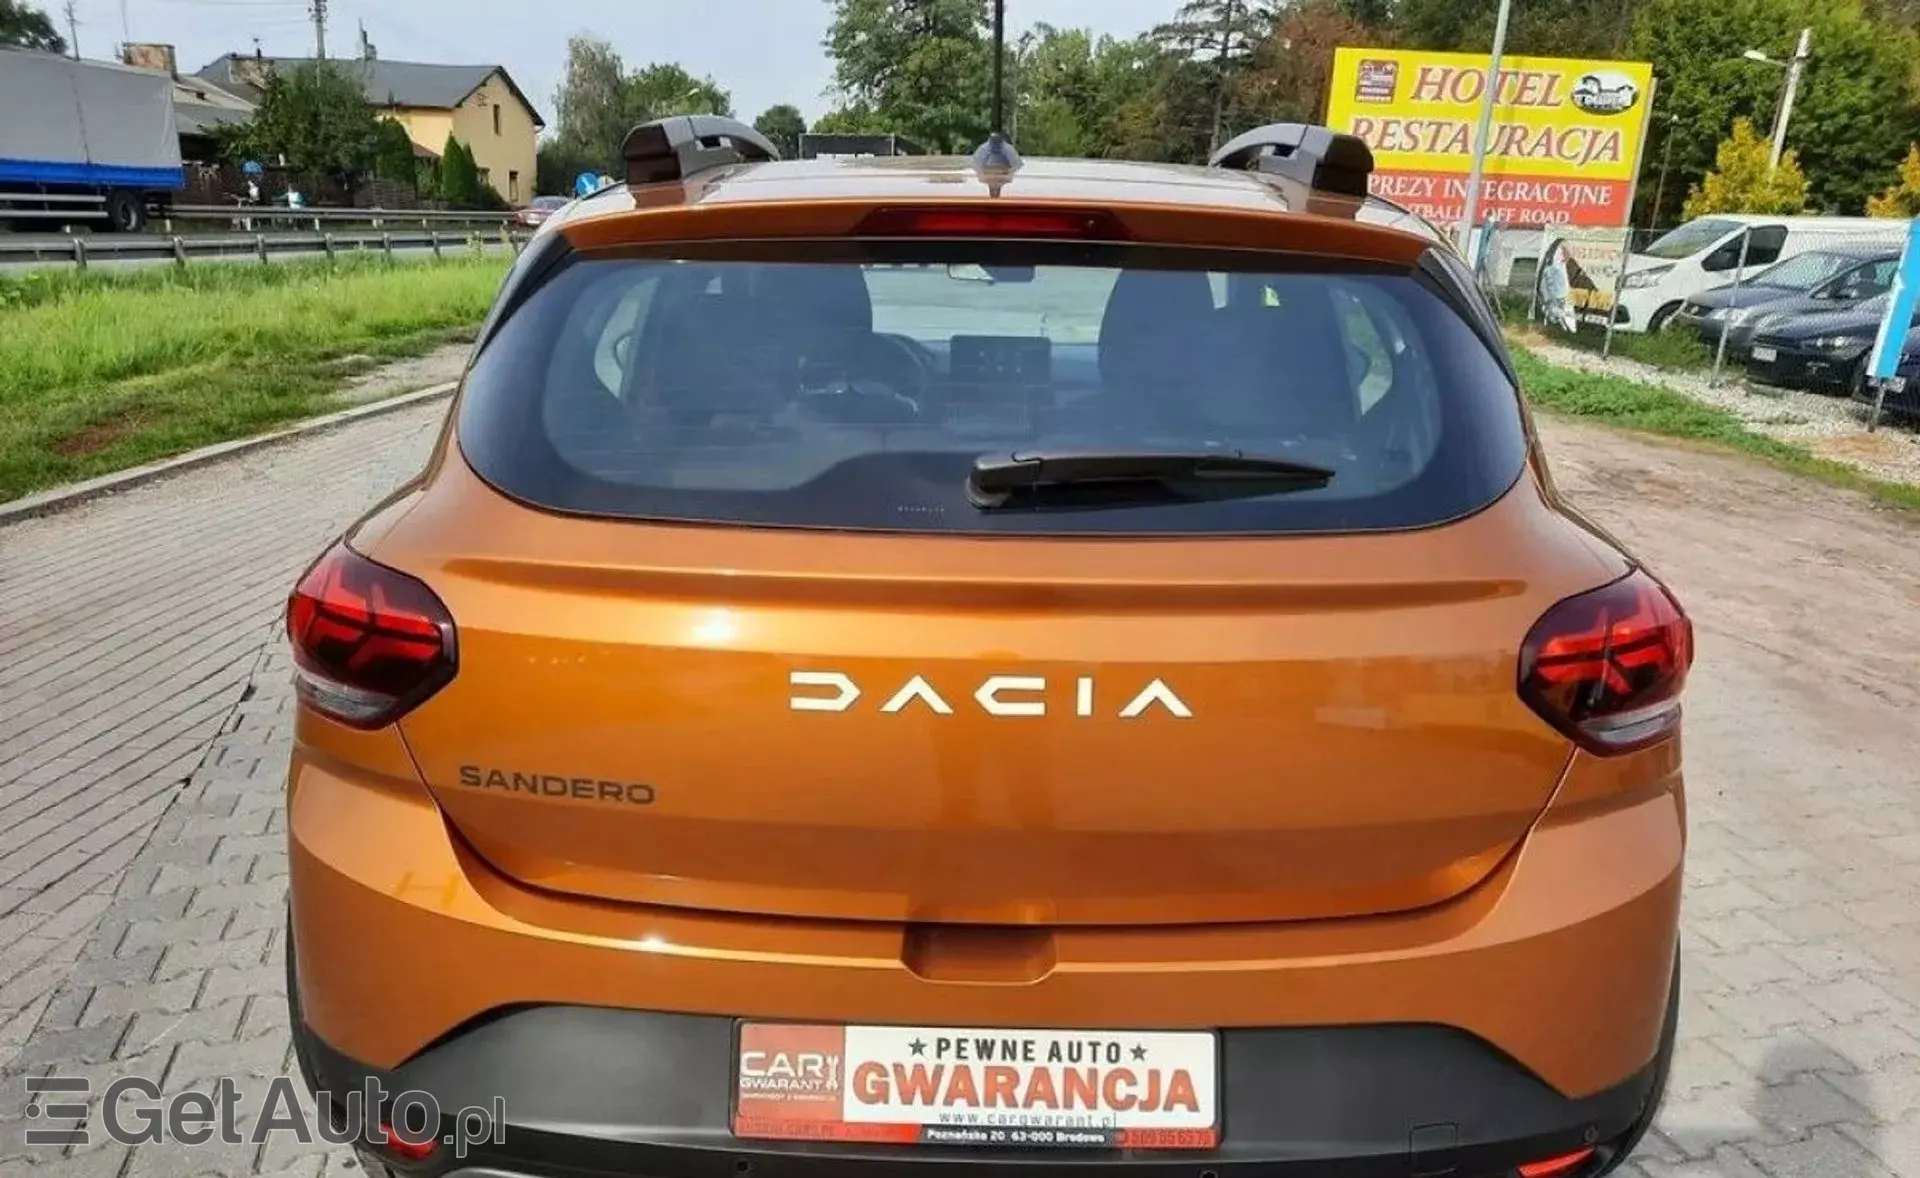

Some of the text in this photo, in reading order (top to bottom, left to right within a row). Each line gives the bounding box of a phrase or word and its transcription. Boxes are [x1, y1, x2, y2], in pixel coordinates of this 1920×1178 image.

[1411, 67, 1562, 107] HOTEL
[1442, 177, 1613, 208] INEGRACYJNE
[1482, 206, 1516, 223] OFF
[1519, 208, 1570, 224] ROAD
[789, 671, 1193, 718] DACIA
[459, 764, 656, 805] SANDERO
[740, 1051, 824, 1078] CAR
[936, 1036, 1123, 1065] PEWNE AUTO
[851, 1060, 1201, 1114] GWARANCJA
